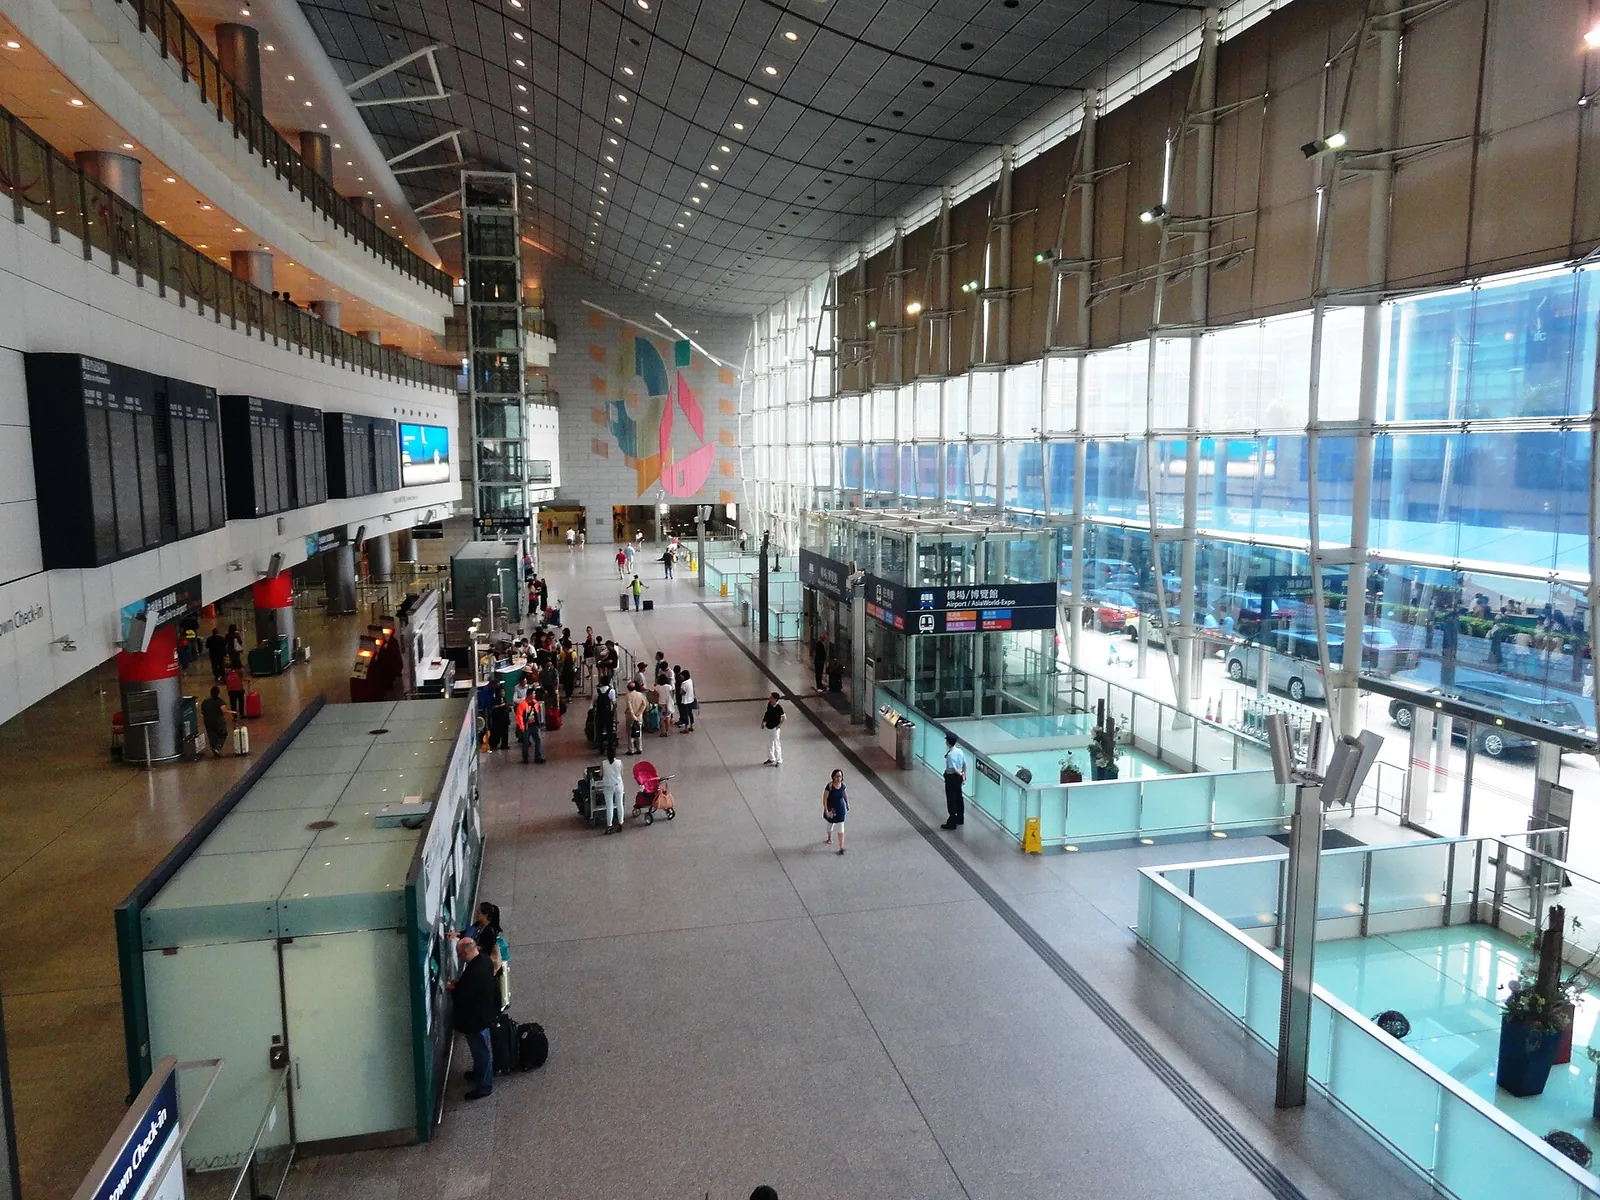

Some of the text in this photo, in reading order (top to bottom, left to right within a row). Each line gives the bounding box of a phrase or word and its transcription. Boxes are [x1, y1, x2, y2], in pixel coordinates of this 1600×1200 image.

[14, 603, 44, 628] Check-in
[971, 599, 1015, 607] AsiaWorld-Expo
[132, 1108, 167, 1170] Check-in
